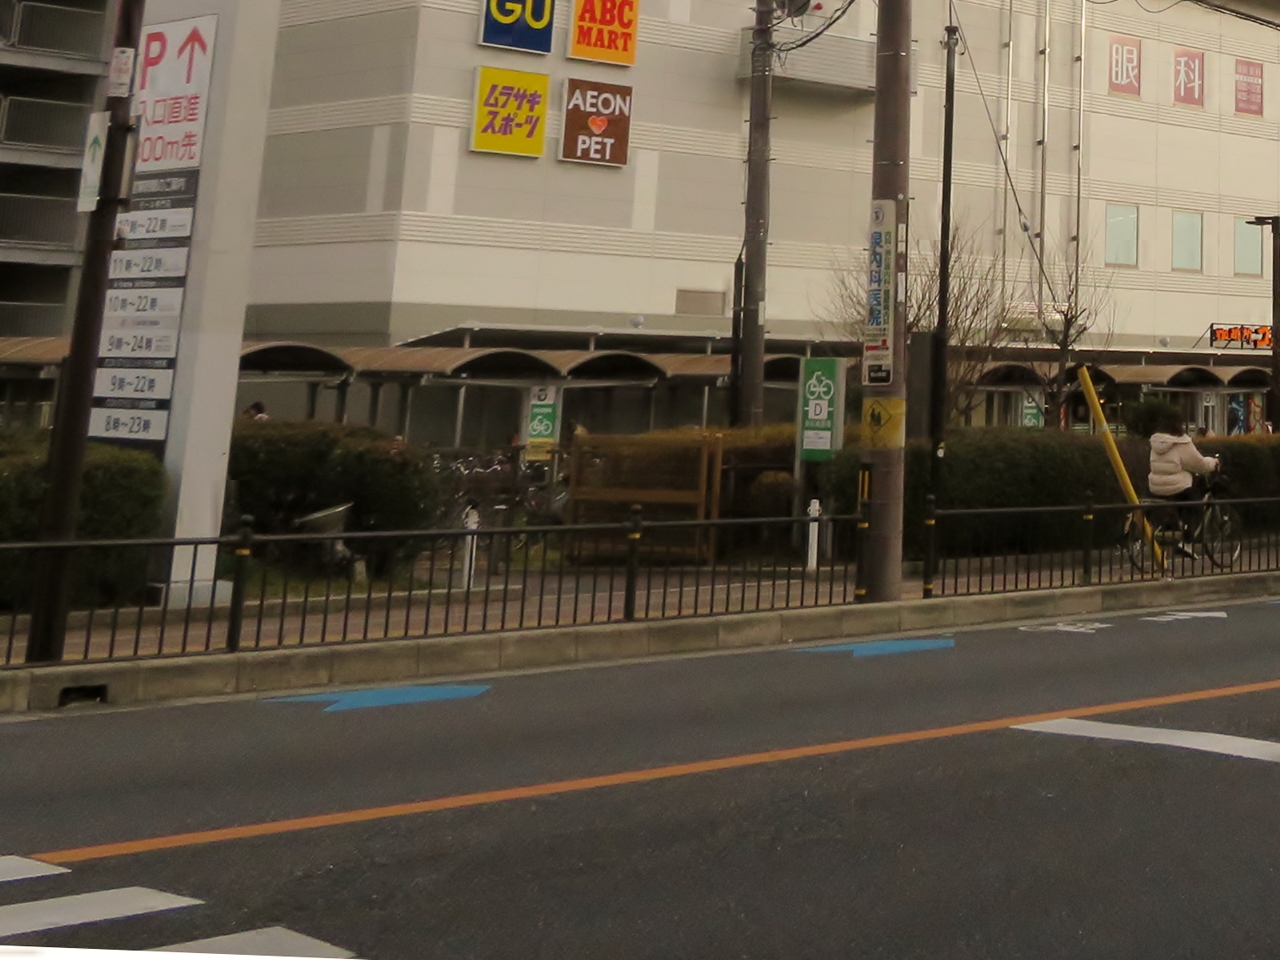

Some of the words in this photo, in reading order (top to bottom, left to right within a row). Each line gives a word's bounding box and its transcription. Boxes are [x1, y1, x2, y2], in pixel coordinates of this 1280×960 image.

[576, 25, 633, 52] MART
[140, 31, 168, 90] P
[483, 84, 542, 112] ムラサキ
[567, 88, 630, 116] AEON
[481, 110, 540, 138] スポーツ
[576, 136, 615, 161] PET
[814, 402, 823, 416] D
